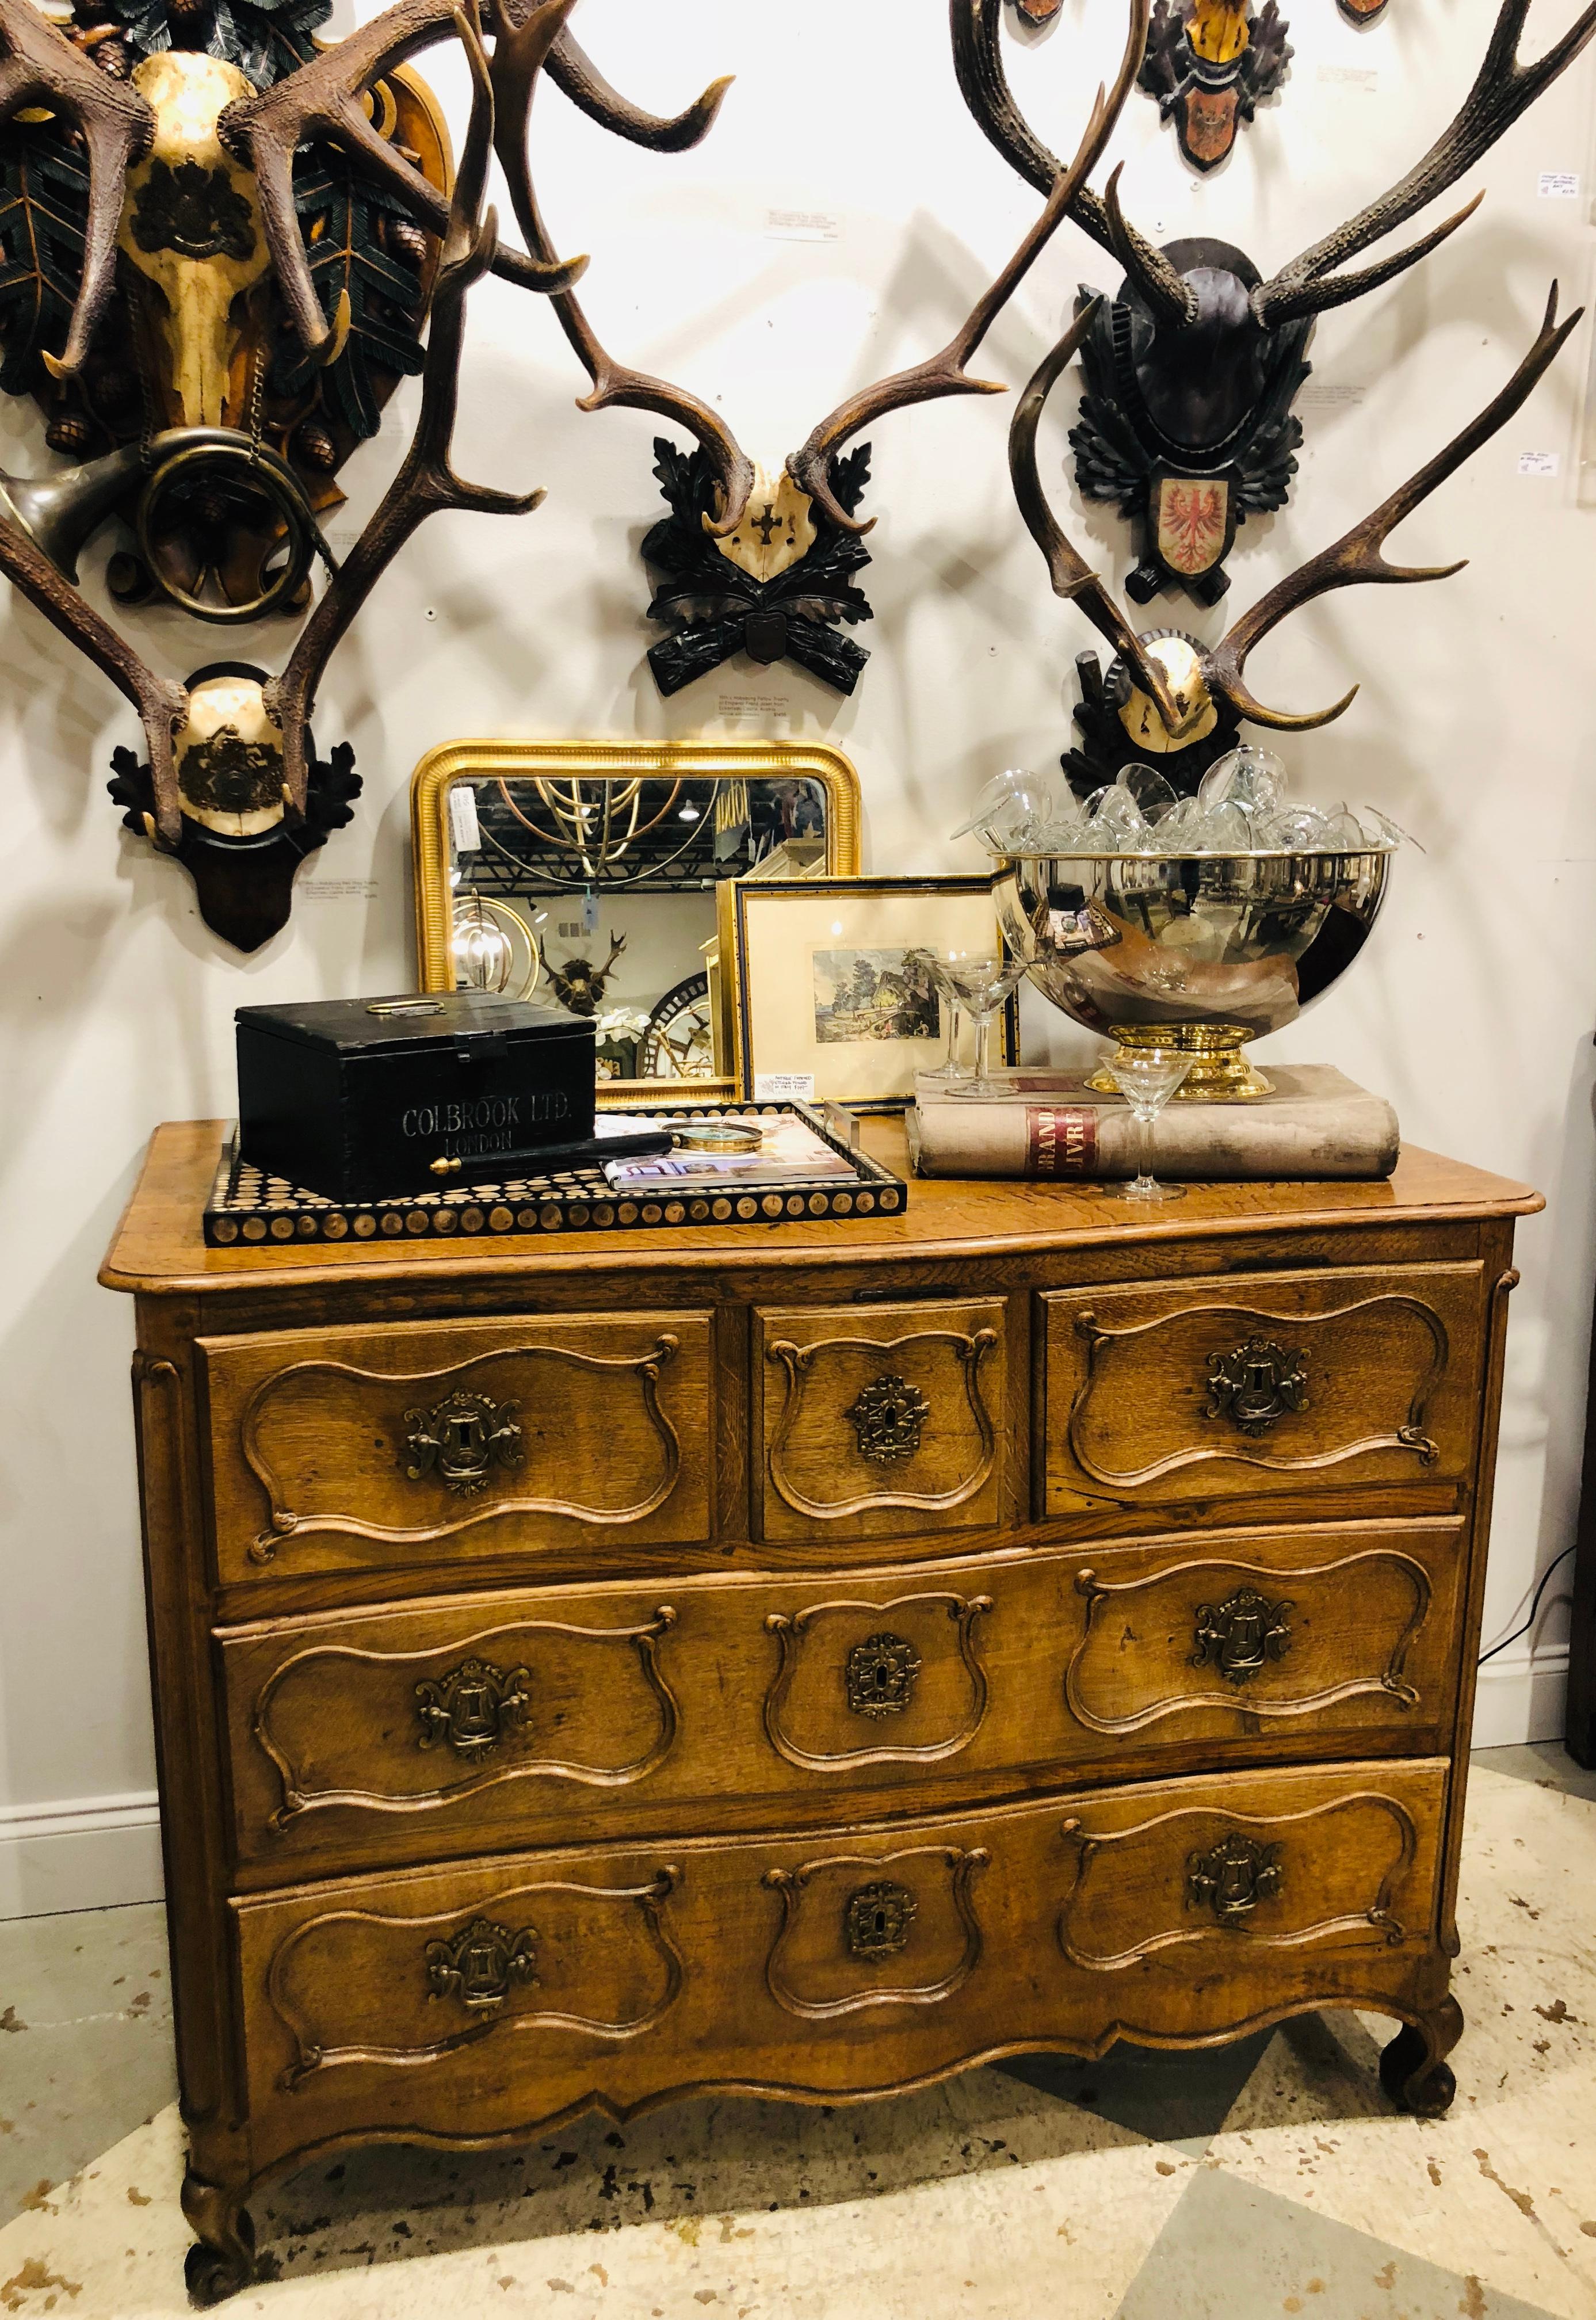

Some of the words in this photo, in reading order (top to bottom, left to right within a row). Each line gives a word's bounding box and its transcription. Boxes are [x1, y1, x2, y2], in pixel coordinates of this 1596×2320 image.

[403, 1097, 520, 1137] COLBROOK
[532, 1092, 572, 1121] LTD.
[445, 1131, 511, 1157] LONDON
